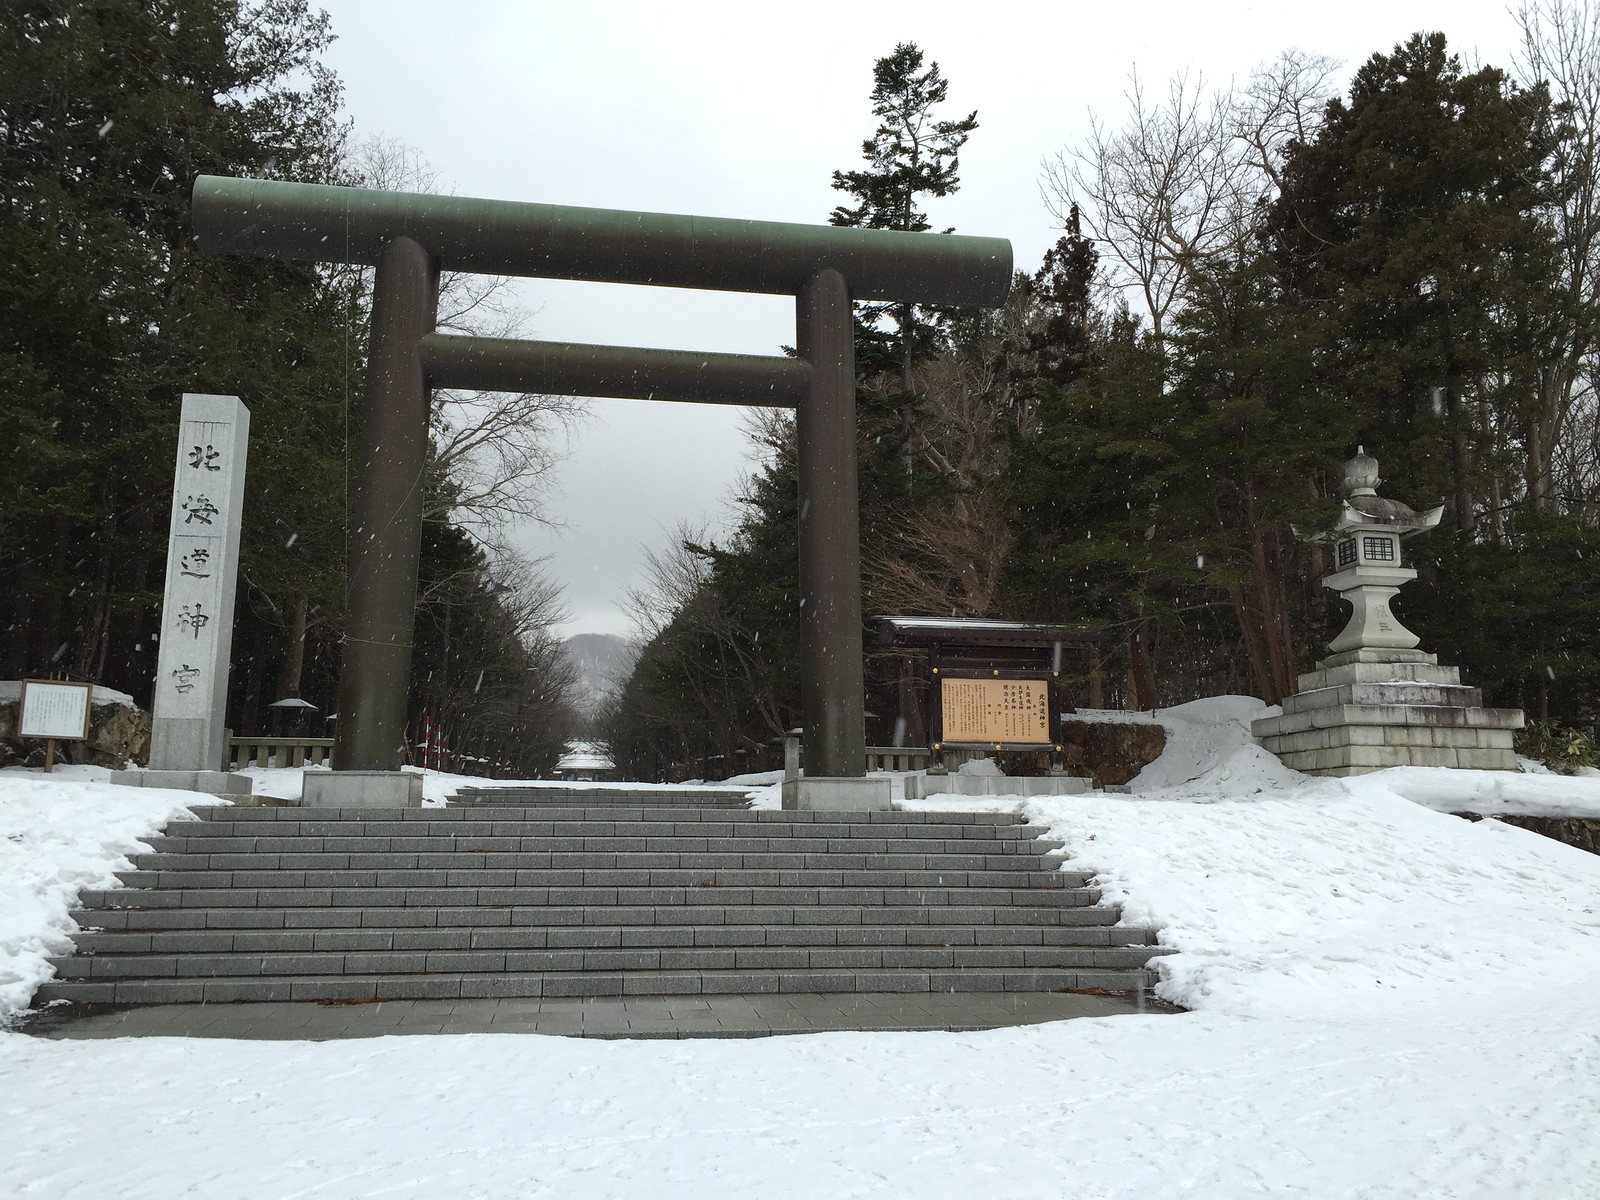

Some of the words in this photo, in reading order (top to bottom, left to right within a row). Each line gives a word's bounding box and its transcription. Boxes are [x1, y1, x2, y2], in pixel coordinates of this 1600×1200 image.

[171, 444, 221, 695] 北海道神宮
